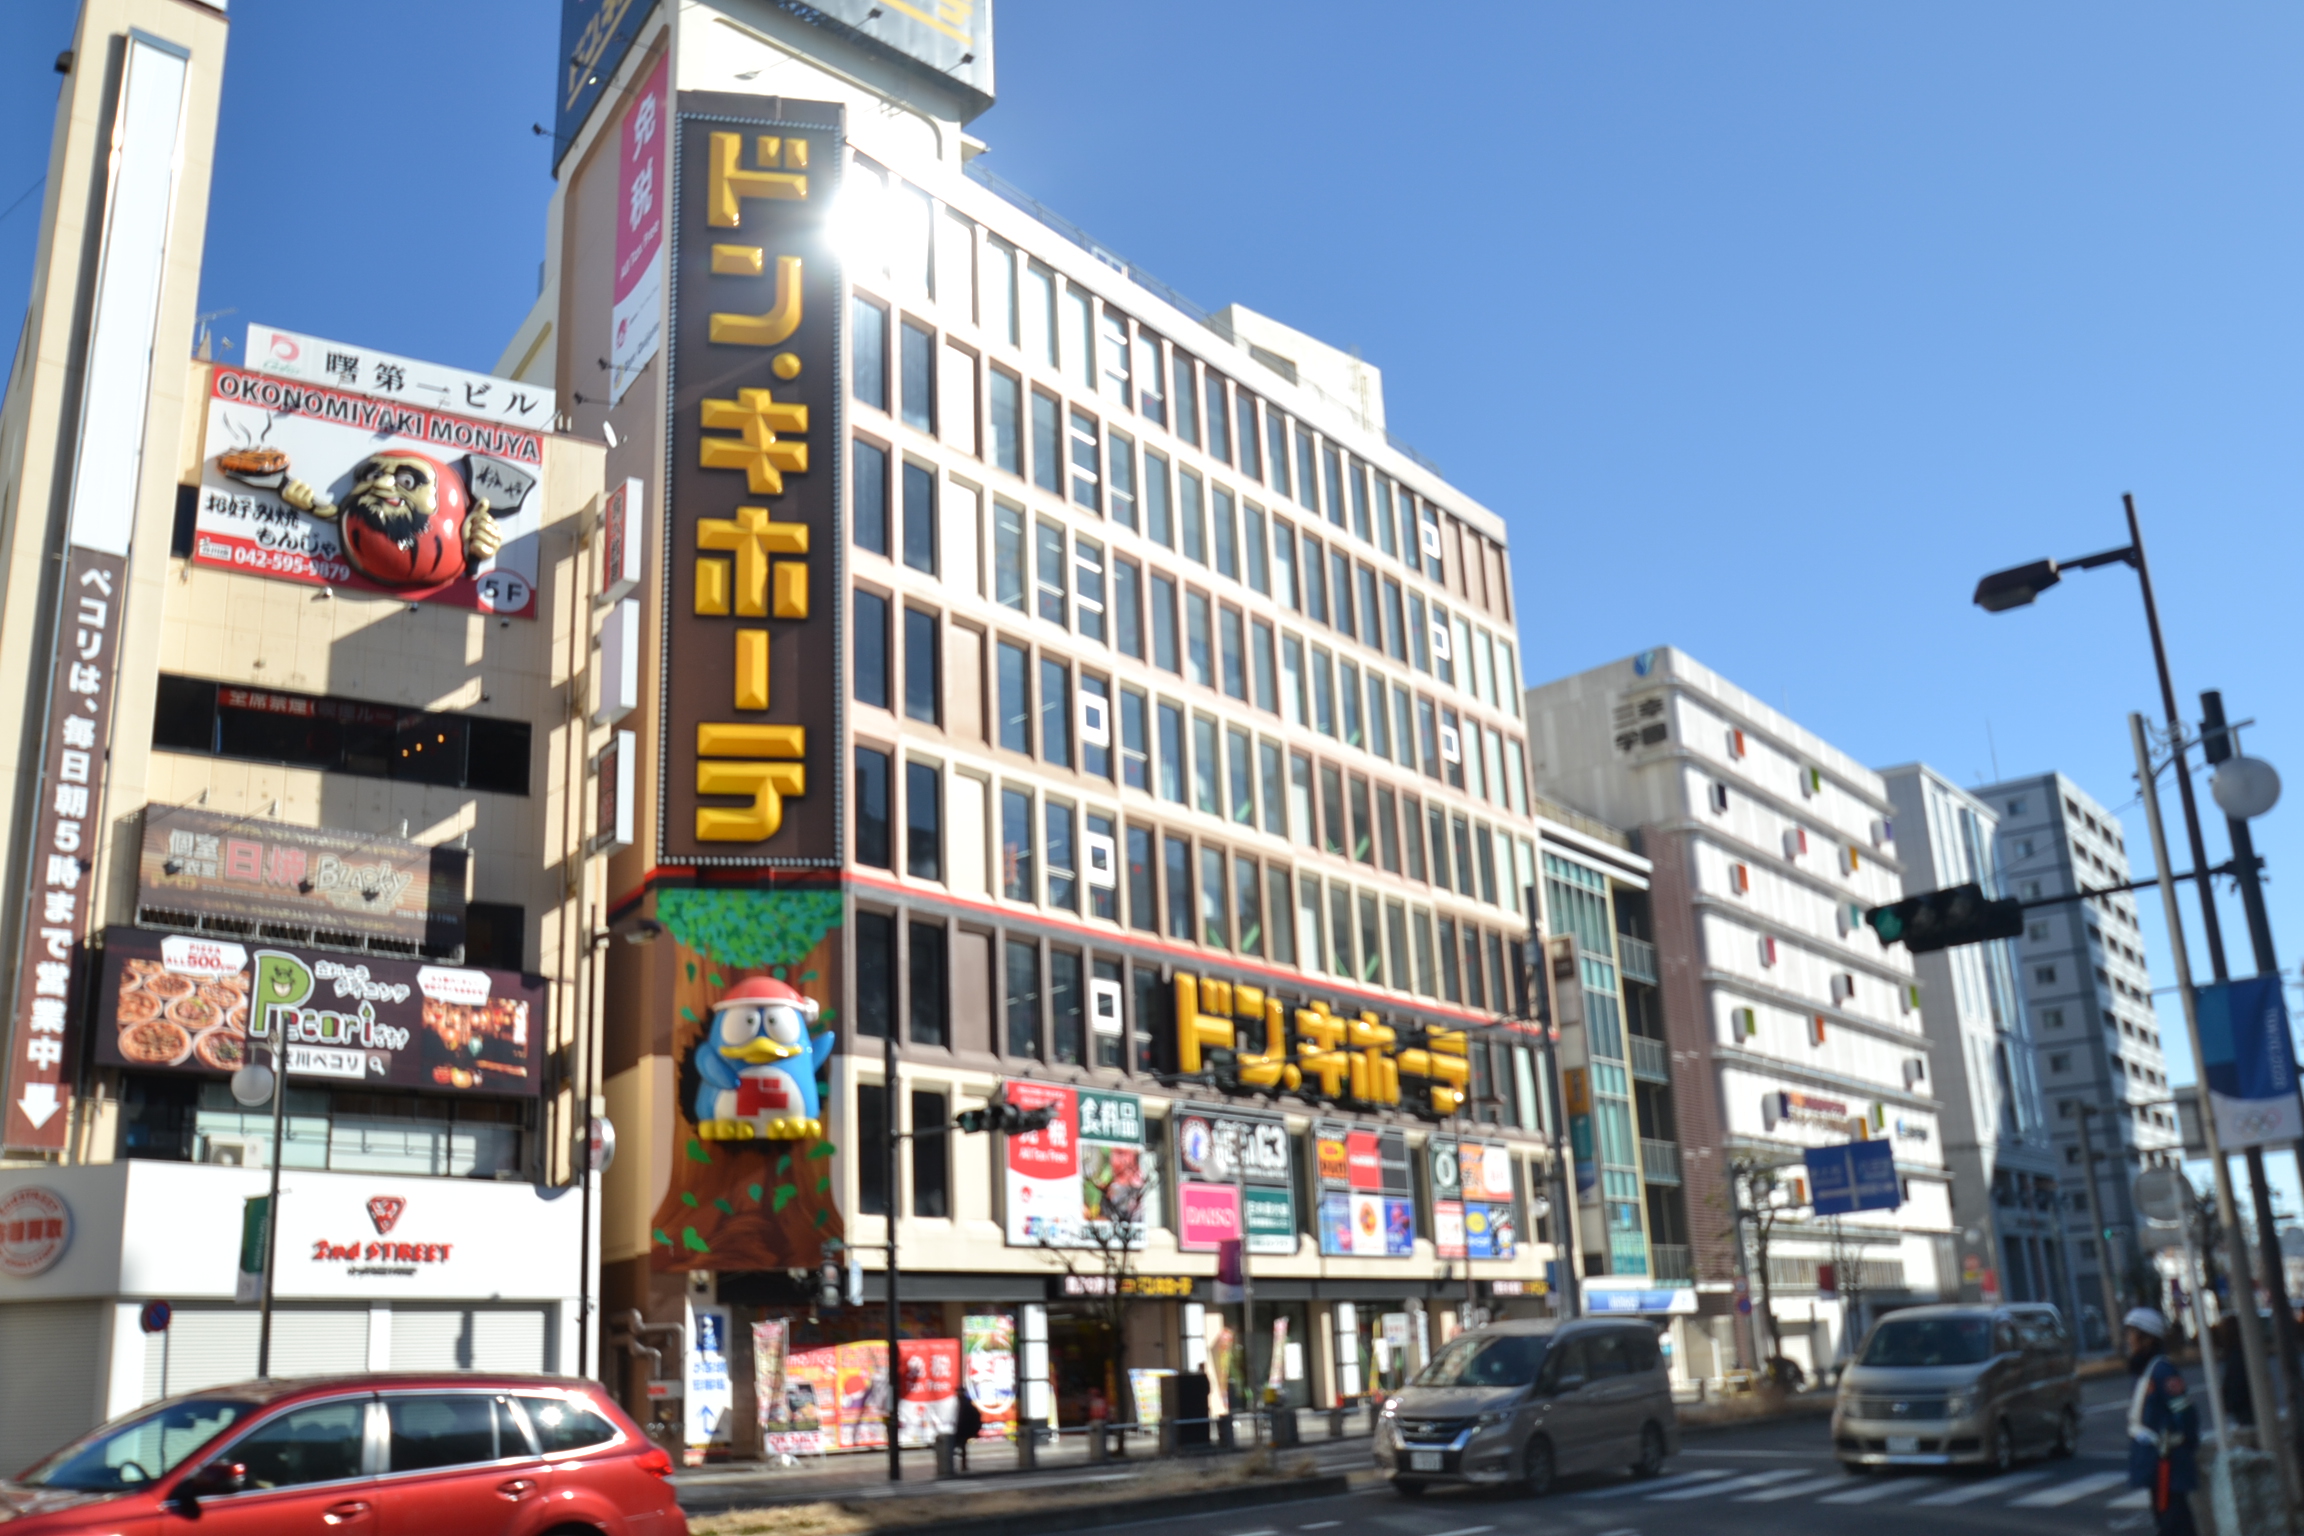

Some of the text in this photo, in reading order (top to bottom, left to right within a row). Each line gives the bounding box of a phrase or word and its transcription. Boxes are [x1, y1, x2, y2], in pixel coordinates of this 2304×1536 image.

[630, 91, 656, 231] 免税
[218, 374, 540, 462] OKONOMIYAKI MONJYA
[27, 568, 112, 1071] ペコリは、毎日朝5時まで営業中
[312, 1240, 453, 1263] 2nd STREET
